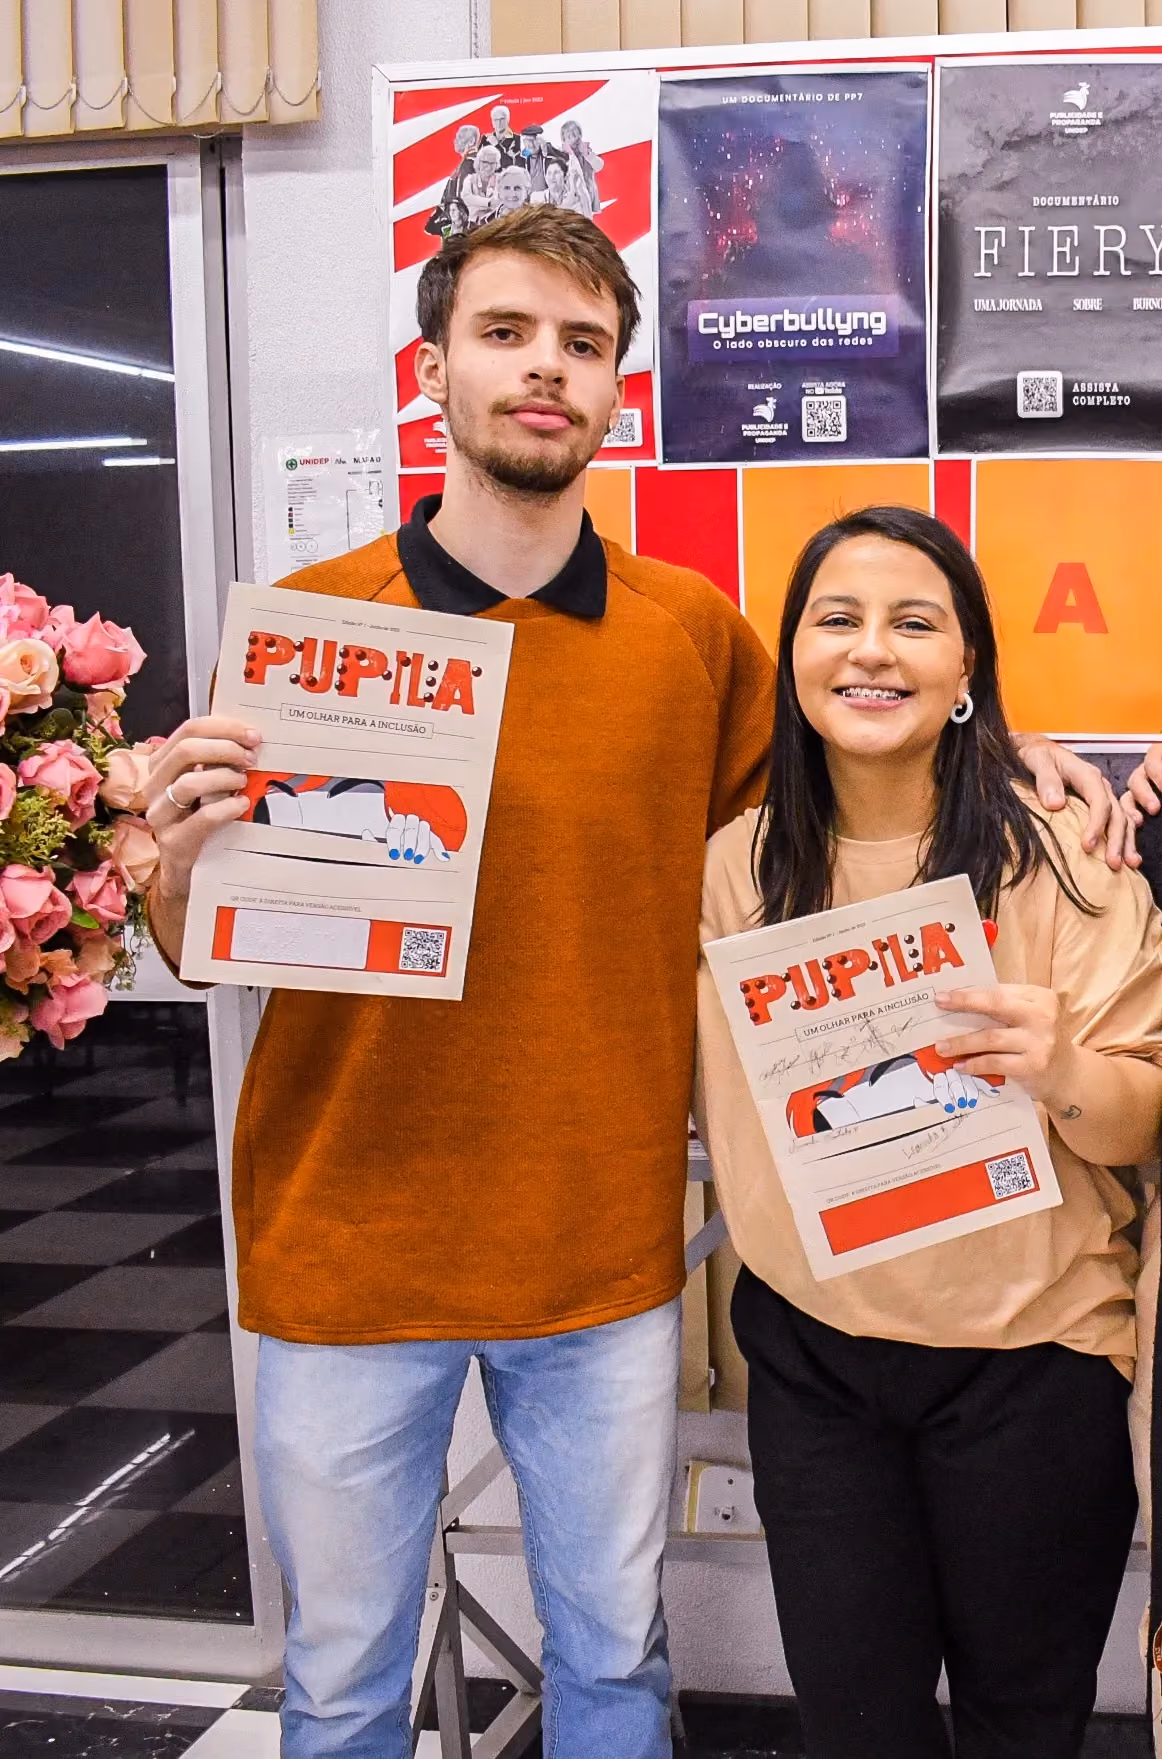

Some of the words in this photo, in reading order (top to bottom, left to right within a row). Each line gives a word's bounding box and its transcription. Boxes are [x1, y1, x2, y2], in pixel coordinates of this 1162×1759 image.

[722, 96, 738, 104] UM
[741, 92, 824, 104] DOCUMENTÁRIO
[827, 93, 840, 102] DE
[844, 92, 864, 101] PP7
[1032, 193, 1120, 207] DOCUMENTÁRIO
[973, 298, 996, 312] UMA
[996, 298, 1043, 312] JORNADA
[1073, 298, 1103, 311] SOBRE
[697, 307, 887, 339] Cyberbullyng
[712, 340, 722, 350] O
[726, 339, 753, 349] lado
[757, 337, 808, 348] obscuro
[811, 337, 834, 347] das
[838, 336, 873, 346] redes
[1072, 382, 1119, 393] ASSISTA
[1072, 395, 1131, 406] COMPLETO
[299, 458, 330, 466] UNIDEP
[1033, 562, 1109, 634] A
[244, 631, 482, 715] PUPILA
[288, 708, 305, 719] UM
[306, 711, 340, 723] OLHAR
[341, 715, 367, 727] PARA
[369, 719, 376, 728] A
[377, 720, 427, 734] INCLUSÃO
[740, 921, 966, 1026] PUPILA
[803, 1027, 819, 1037] UM
[819, 1017, 850, 1032] OLHAR
[851, 1009, 876, 1022] PARA
[877, 1007, 884, 1015] A
[884, 992, 929, 1012] INCLUSÃO
